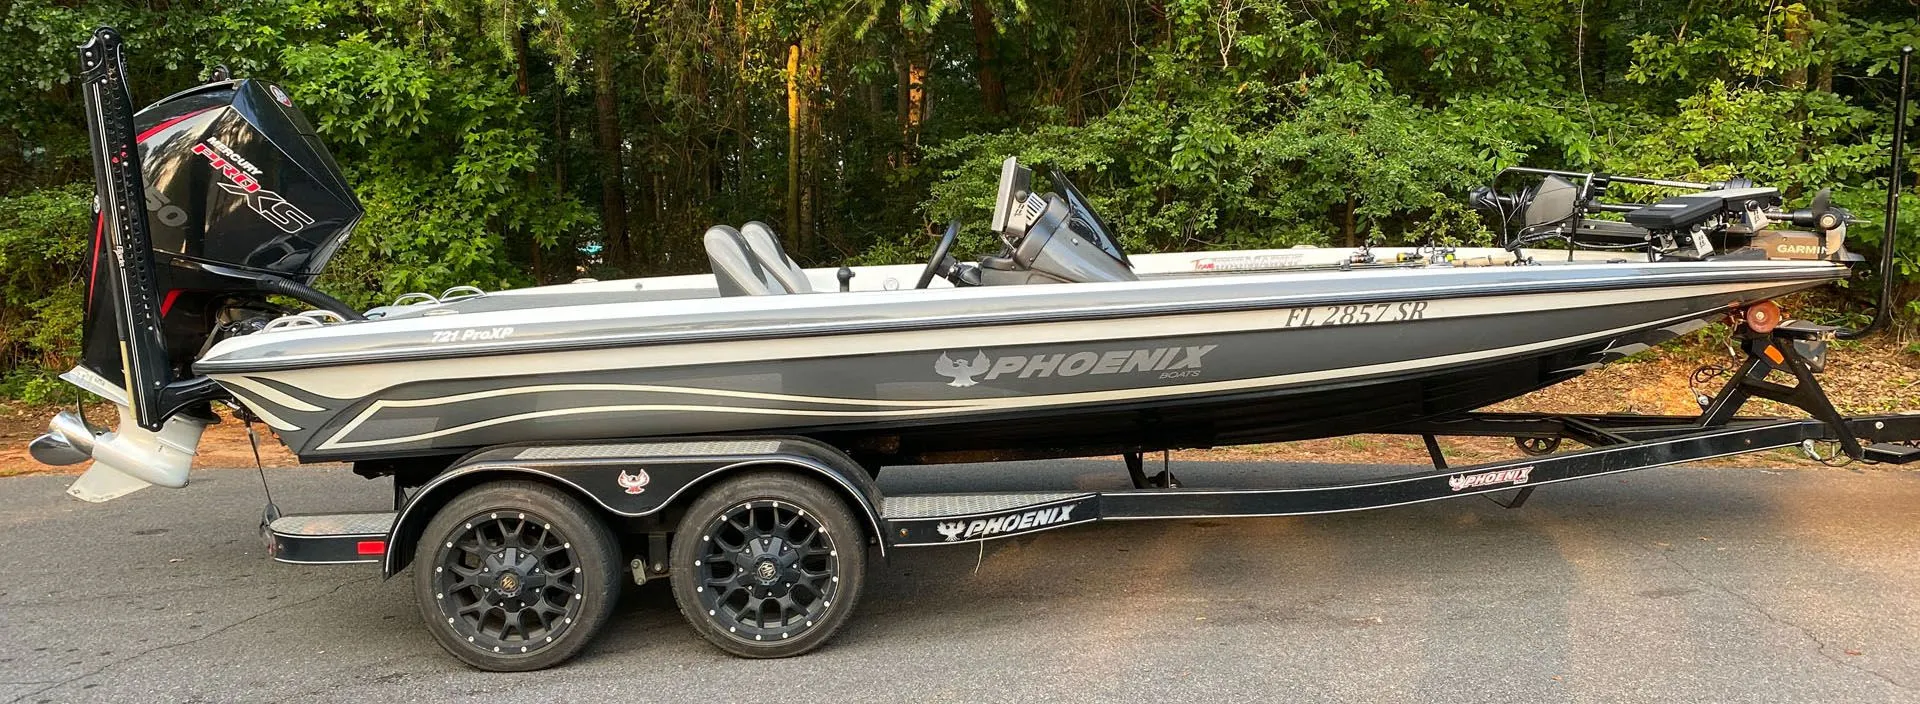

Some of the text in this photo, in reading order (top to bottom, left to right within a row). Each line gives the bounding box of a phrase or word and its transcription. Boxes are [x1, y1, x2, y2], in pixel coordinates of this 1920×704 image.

[191, 143, 261, 193] PRO
[206, 136, 263, 176] MERCURY
[216, 182, 315, 234] XS
[1284, 301, 1429, 328] FL 2857 SR
[431, 327, 514, 343] 721 ProXP
[983, 344, 1219, 381] PHOENIX
[1159, 370, 1201, 380] BOATS
[1464, 465, 1535, 487] PHOENIX
[964, 504, 1076, 538] PHOENIX
